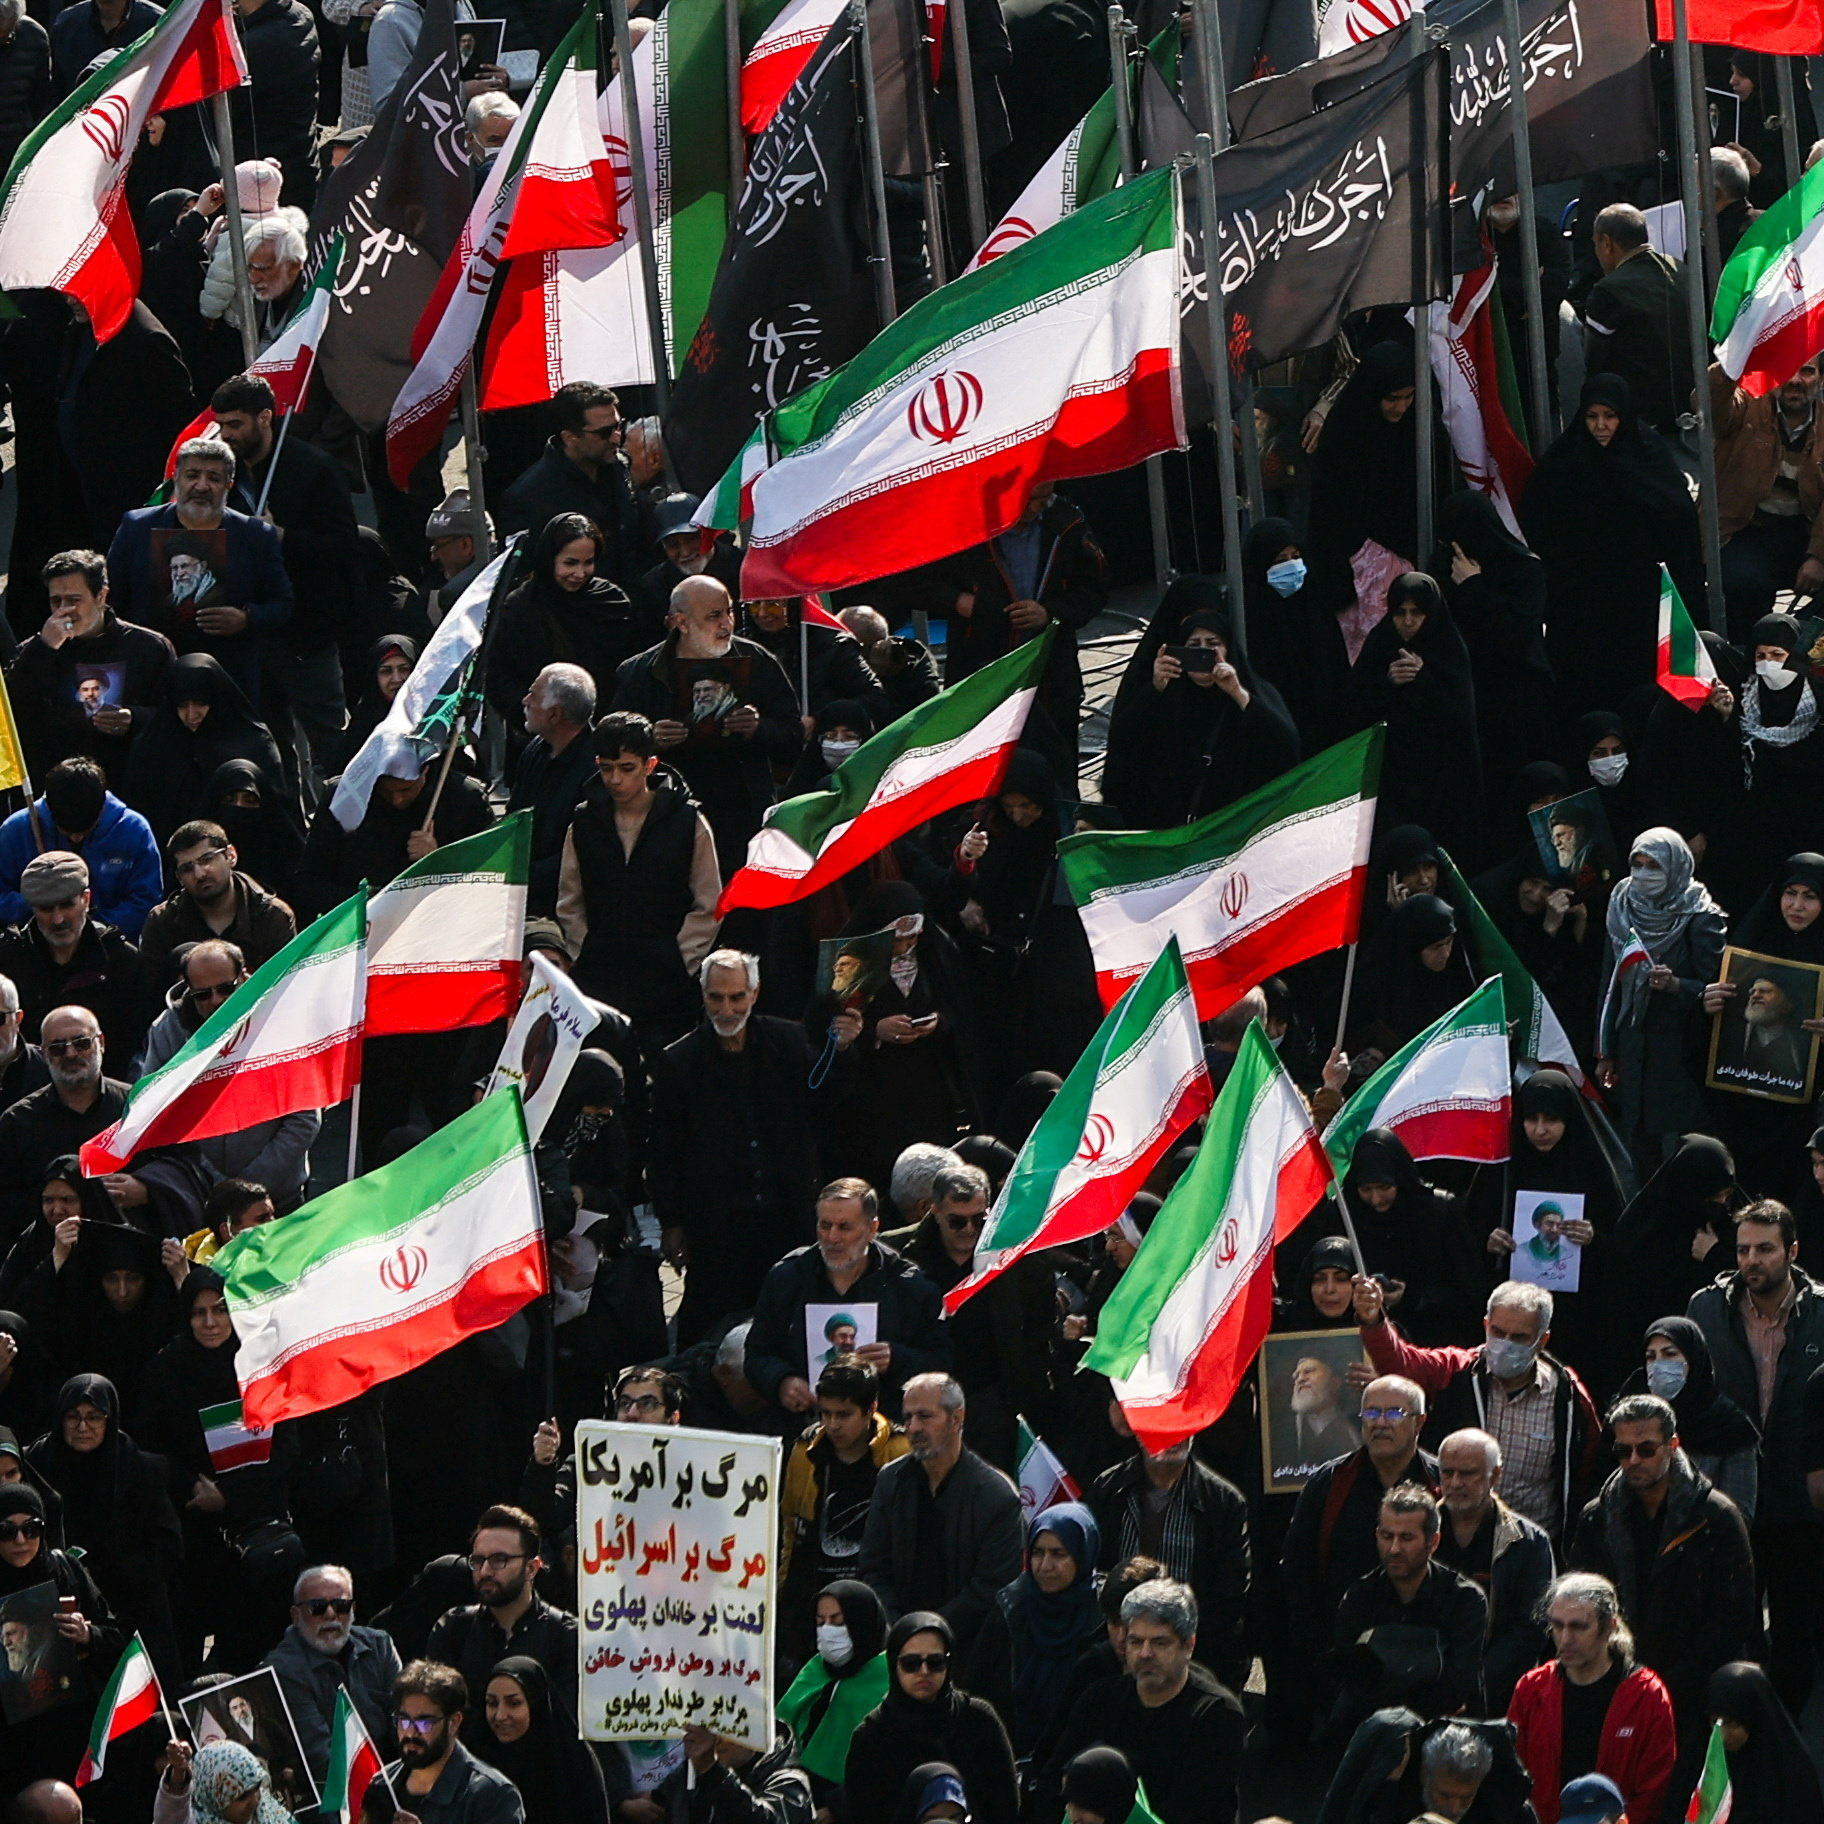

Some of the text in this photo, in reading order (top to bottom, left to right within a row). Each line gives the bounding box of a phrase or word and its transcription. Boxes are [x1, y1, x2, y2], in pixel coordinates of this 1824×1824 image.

[564, 1016, 583, 1040] سلام
[1716, 1063, 1736, 1076] دادی
[1735, 1068, 1759, 1081] طوفان
[581, 1436, 768, 1518] مرگ بر آمریکا
[1273, 1465, 1294, 1478] دادی
[583, 1512, 766, 1589] مرگ بر اسرائیل
[584, 1584, 766, 1637] لعنت بر خاندان پهلوی
[584, 1646, 626, 1675] خائن
[678, 1652, 715, 1678] وطن
[718, 1657, 732, 1678] بر
[732, 1658, 762, 1687] مرگ
[605, 1687, 748, 1724] مرگ بر طرفدار پهلوی
